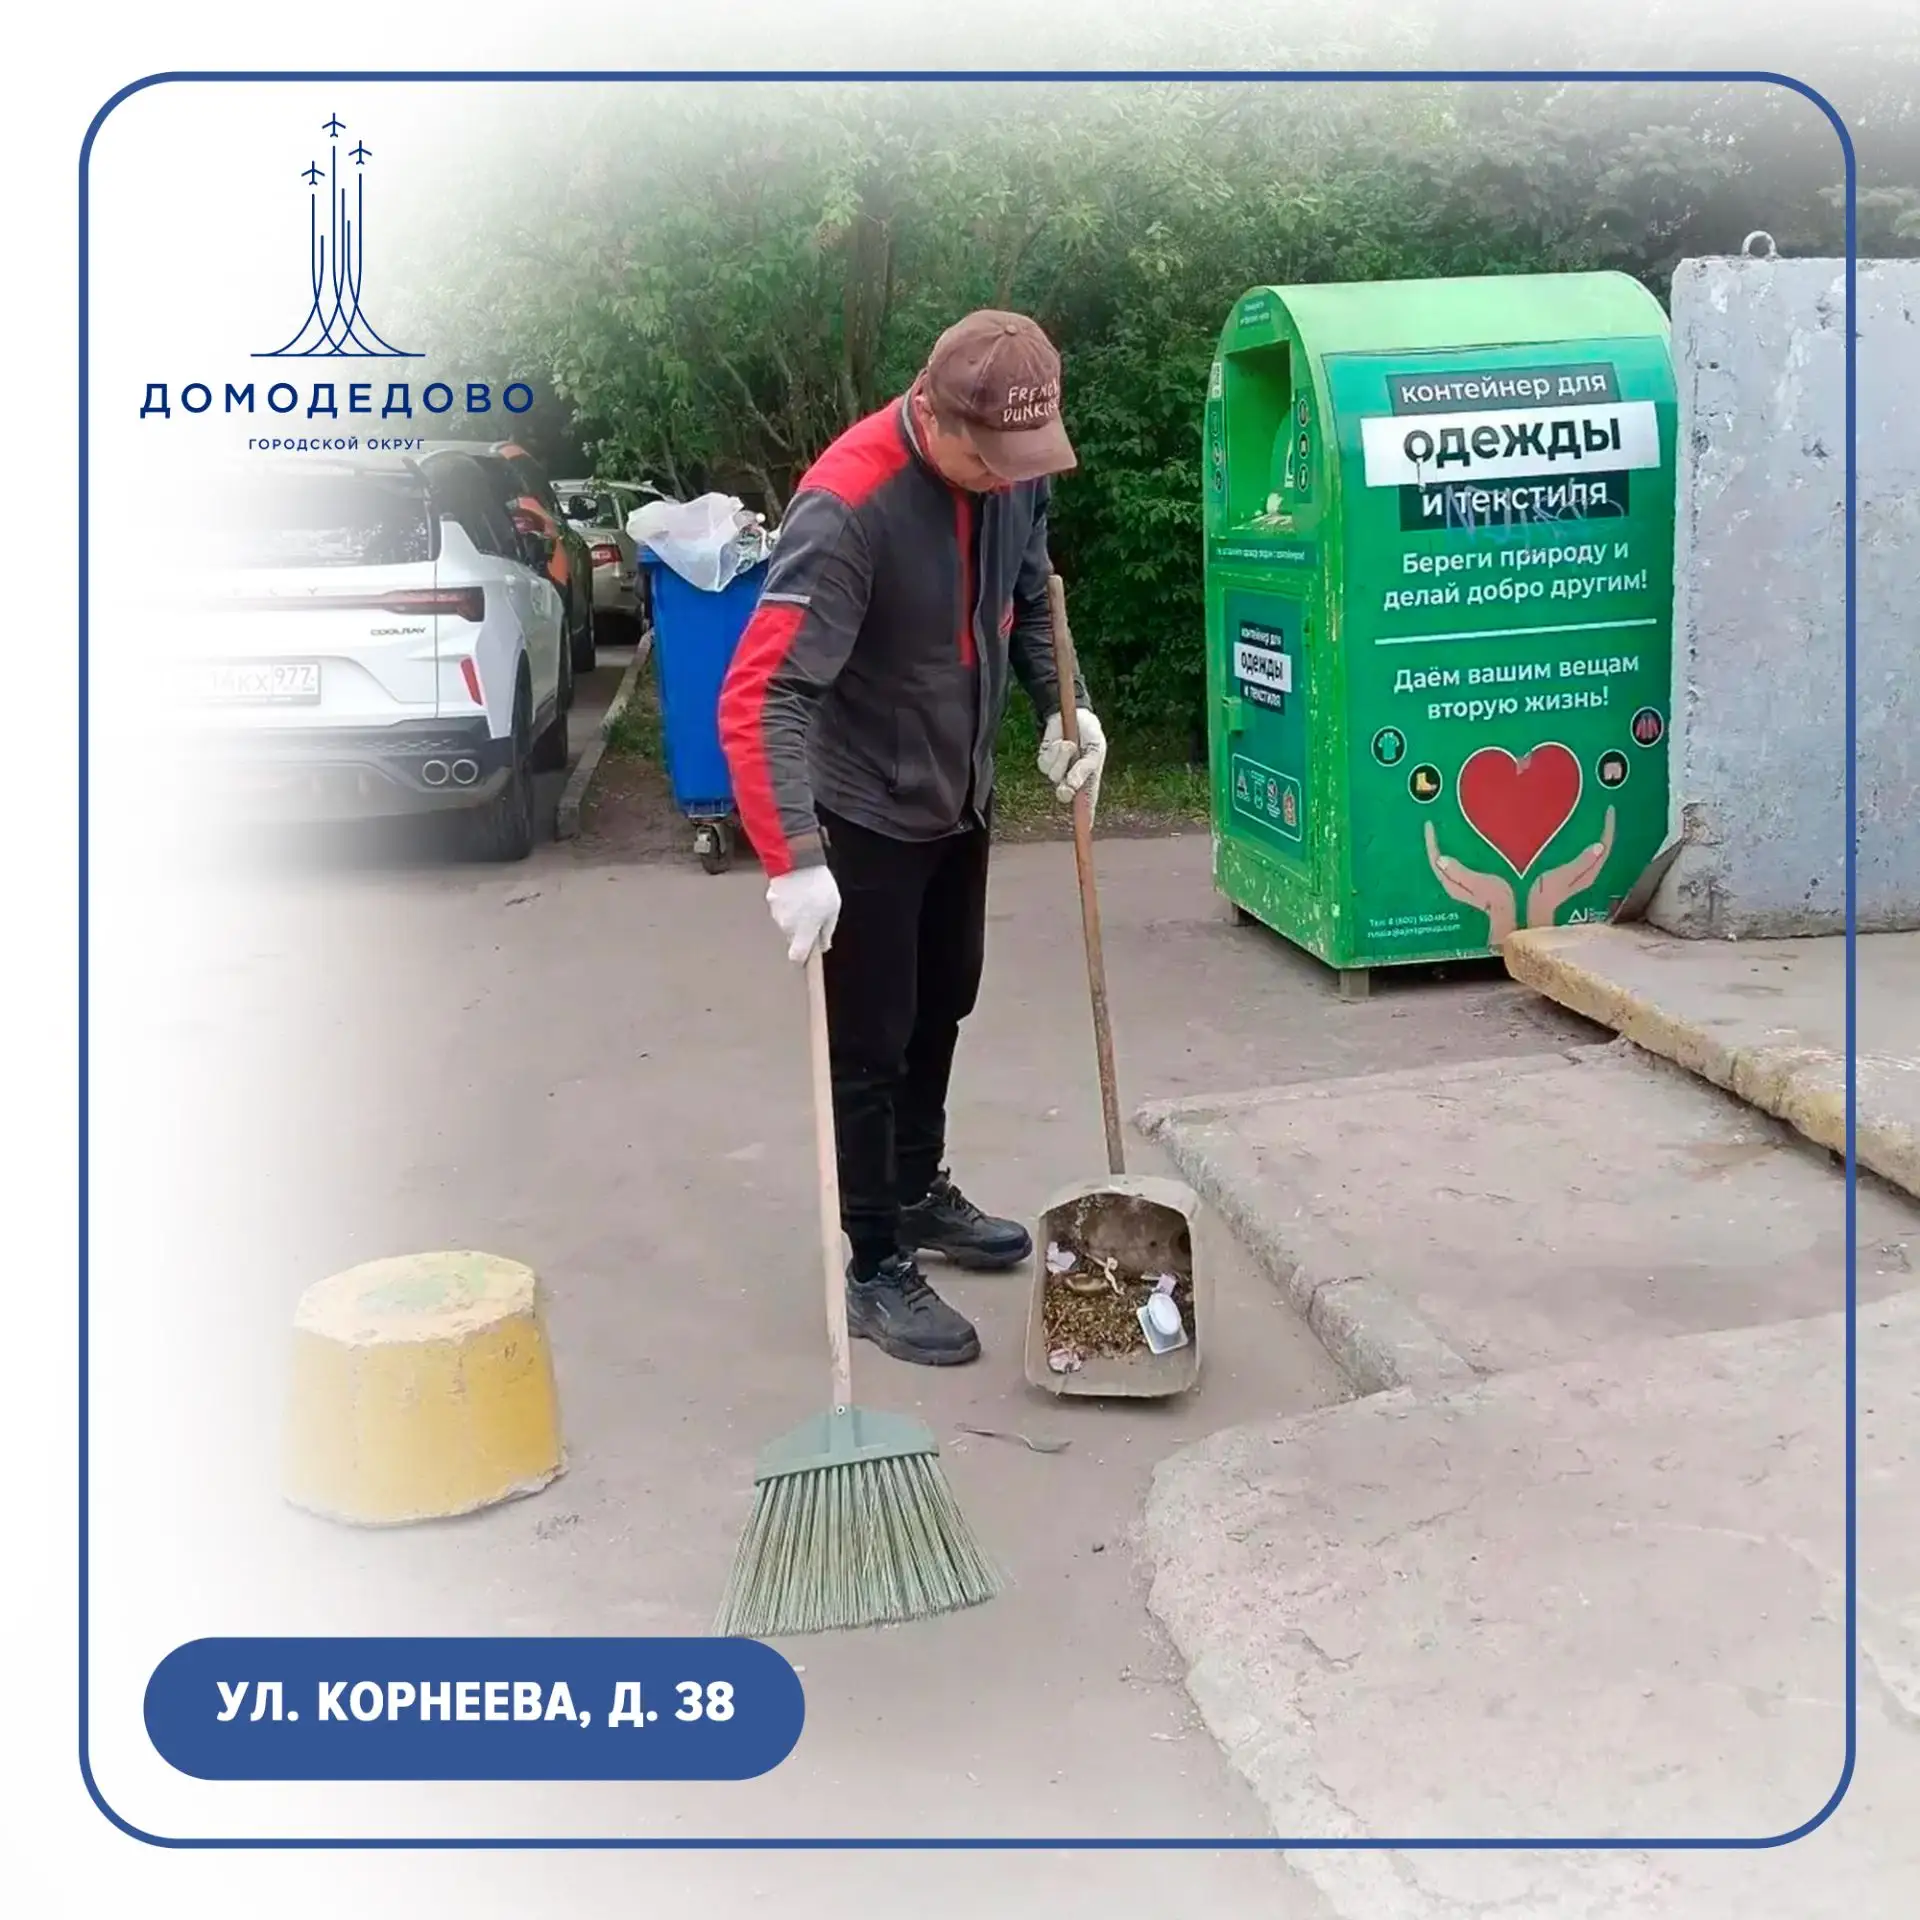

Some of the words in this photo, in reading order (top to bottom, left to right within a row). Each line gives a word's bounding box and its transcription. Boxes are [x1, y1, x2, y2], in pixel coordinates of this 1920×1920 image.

[1401, 376, 1549, 403] контейнер
[1557, 374, 1607, 396] для
[1403, 418, 1621, 469] одежды
[1423, 494, 1443, 516] и
[1454, 481, 1607, 514] текстиля
[1402, 551, 1493, 577] Береги
[1500, 543, 1606, 571] природу
[1614, 542, 1629, 558] и
[1383, 582, 1460, 612] делай
[1467, 578, 1544, 605] добро
[1550, 569, 1648, 600] другим!
[1394, 667, 1460, 694] Даём
[1468, 662, 1551, 684] вашим
[1559, 655, 1639, 678] вещам
[1428, 701, 1518, 721] вторую
[1525, 686, 1609, 712] жизнь!
